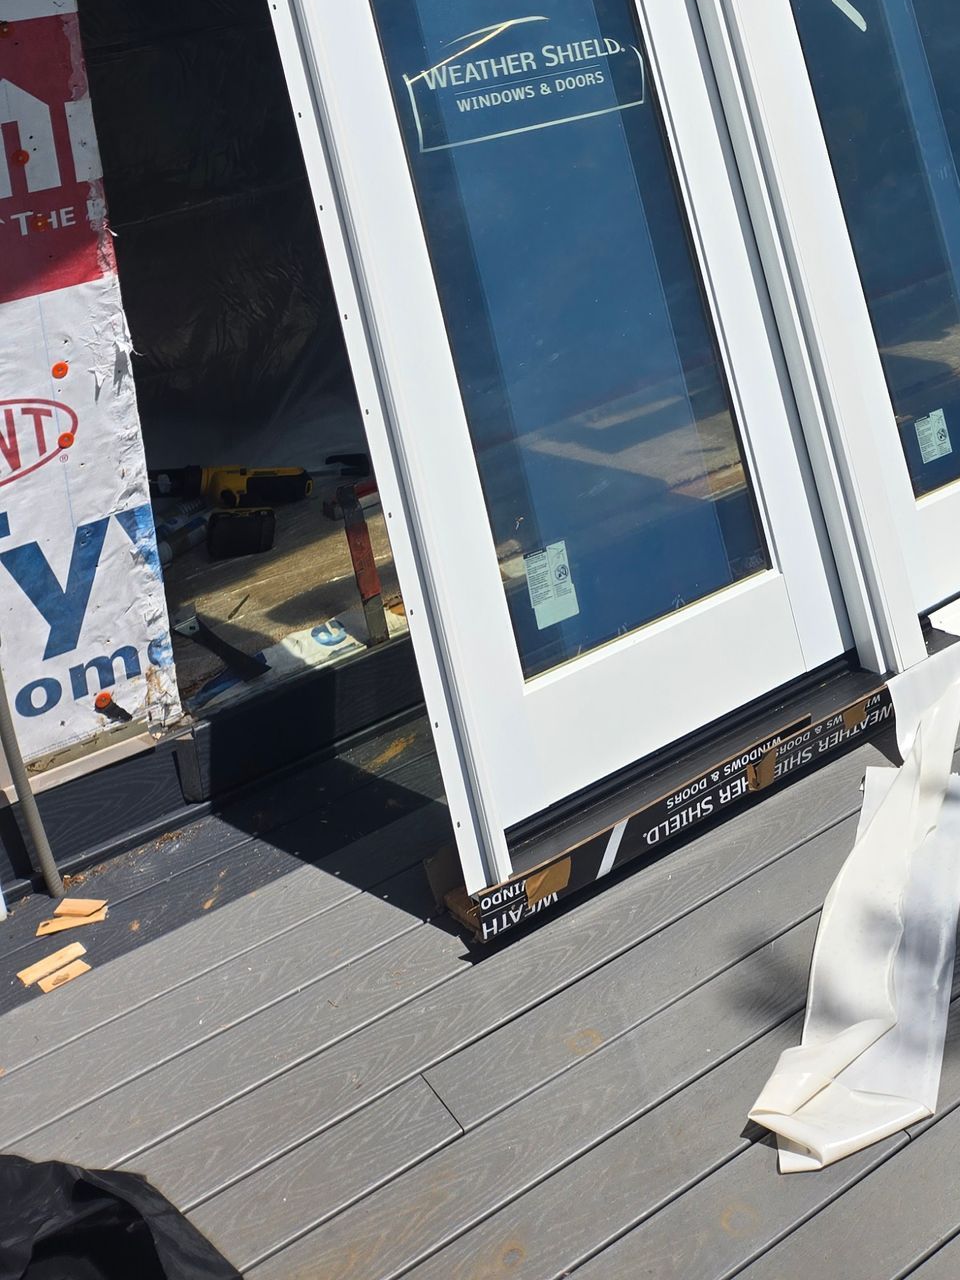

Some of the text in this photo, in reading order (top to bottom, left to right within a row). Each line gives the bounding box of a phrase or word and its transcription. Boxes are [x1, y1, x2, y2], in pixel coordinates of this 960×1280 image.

[421, 51, 537, 90] WEATHER
[456, 70, 605, 113] WINDOWS & DOORS
[814, 725, 824, 735] &
[666, 735, 782, 810] WINDOWS & DOORS
[480, 879, 527, 912] INDO
